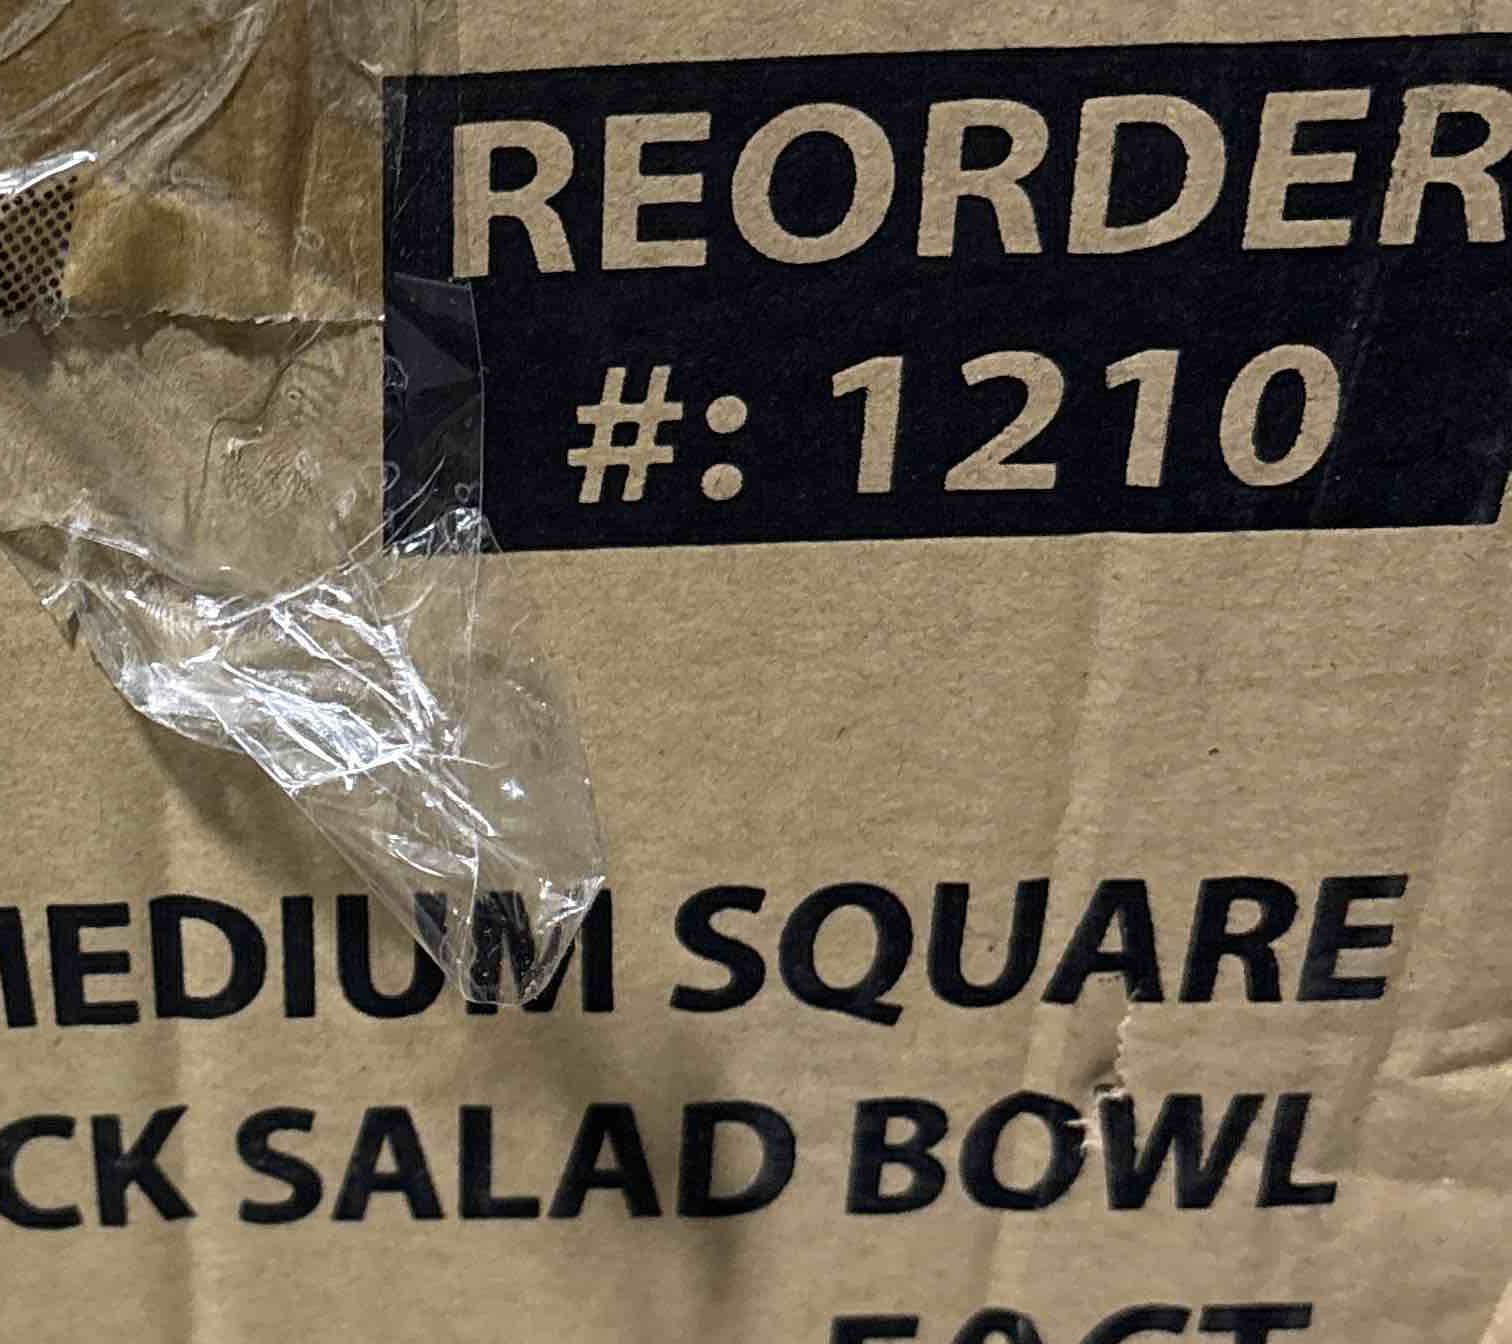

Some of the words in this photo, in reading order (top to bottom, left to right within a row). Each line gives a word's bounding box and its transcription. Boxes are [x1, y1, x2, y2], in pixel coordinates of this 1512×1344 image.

[453, 82, 1512, 278] REORDER
[568, 363, 748, 504] #:
[831, 343, 1342, 494] 1210
[669, 872, 1408, 1027] SQUARE
[236, 1100, 797, 1226] SALAD
[845, 1088, 1339, 1216] BOWL
